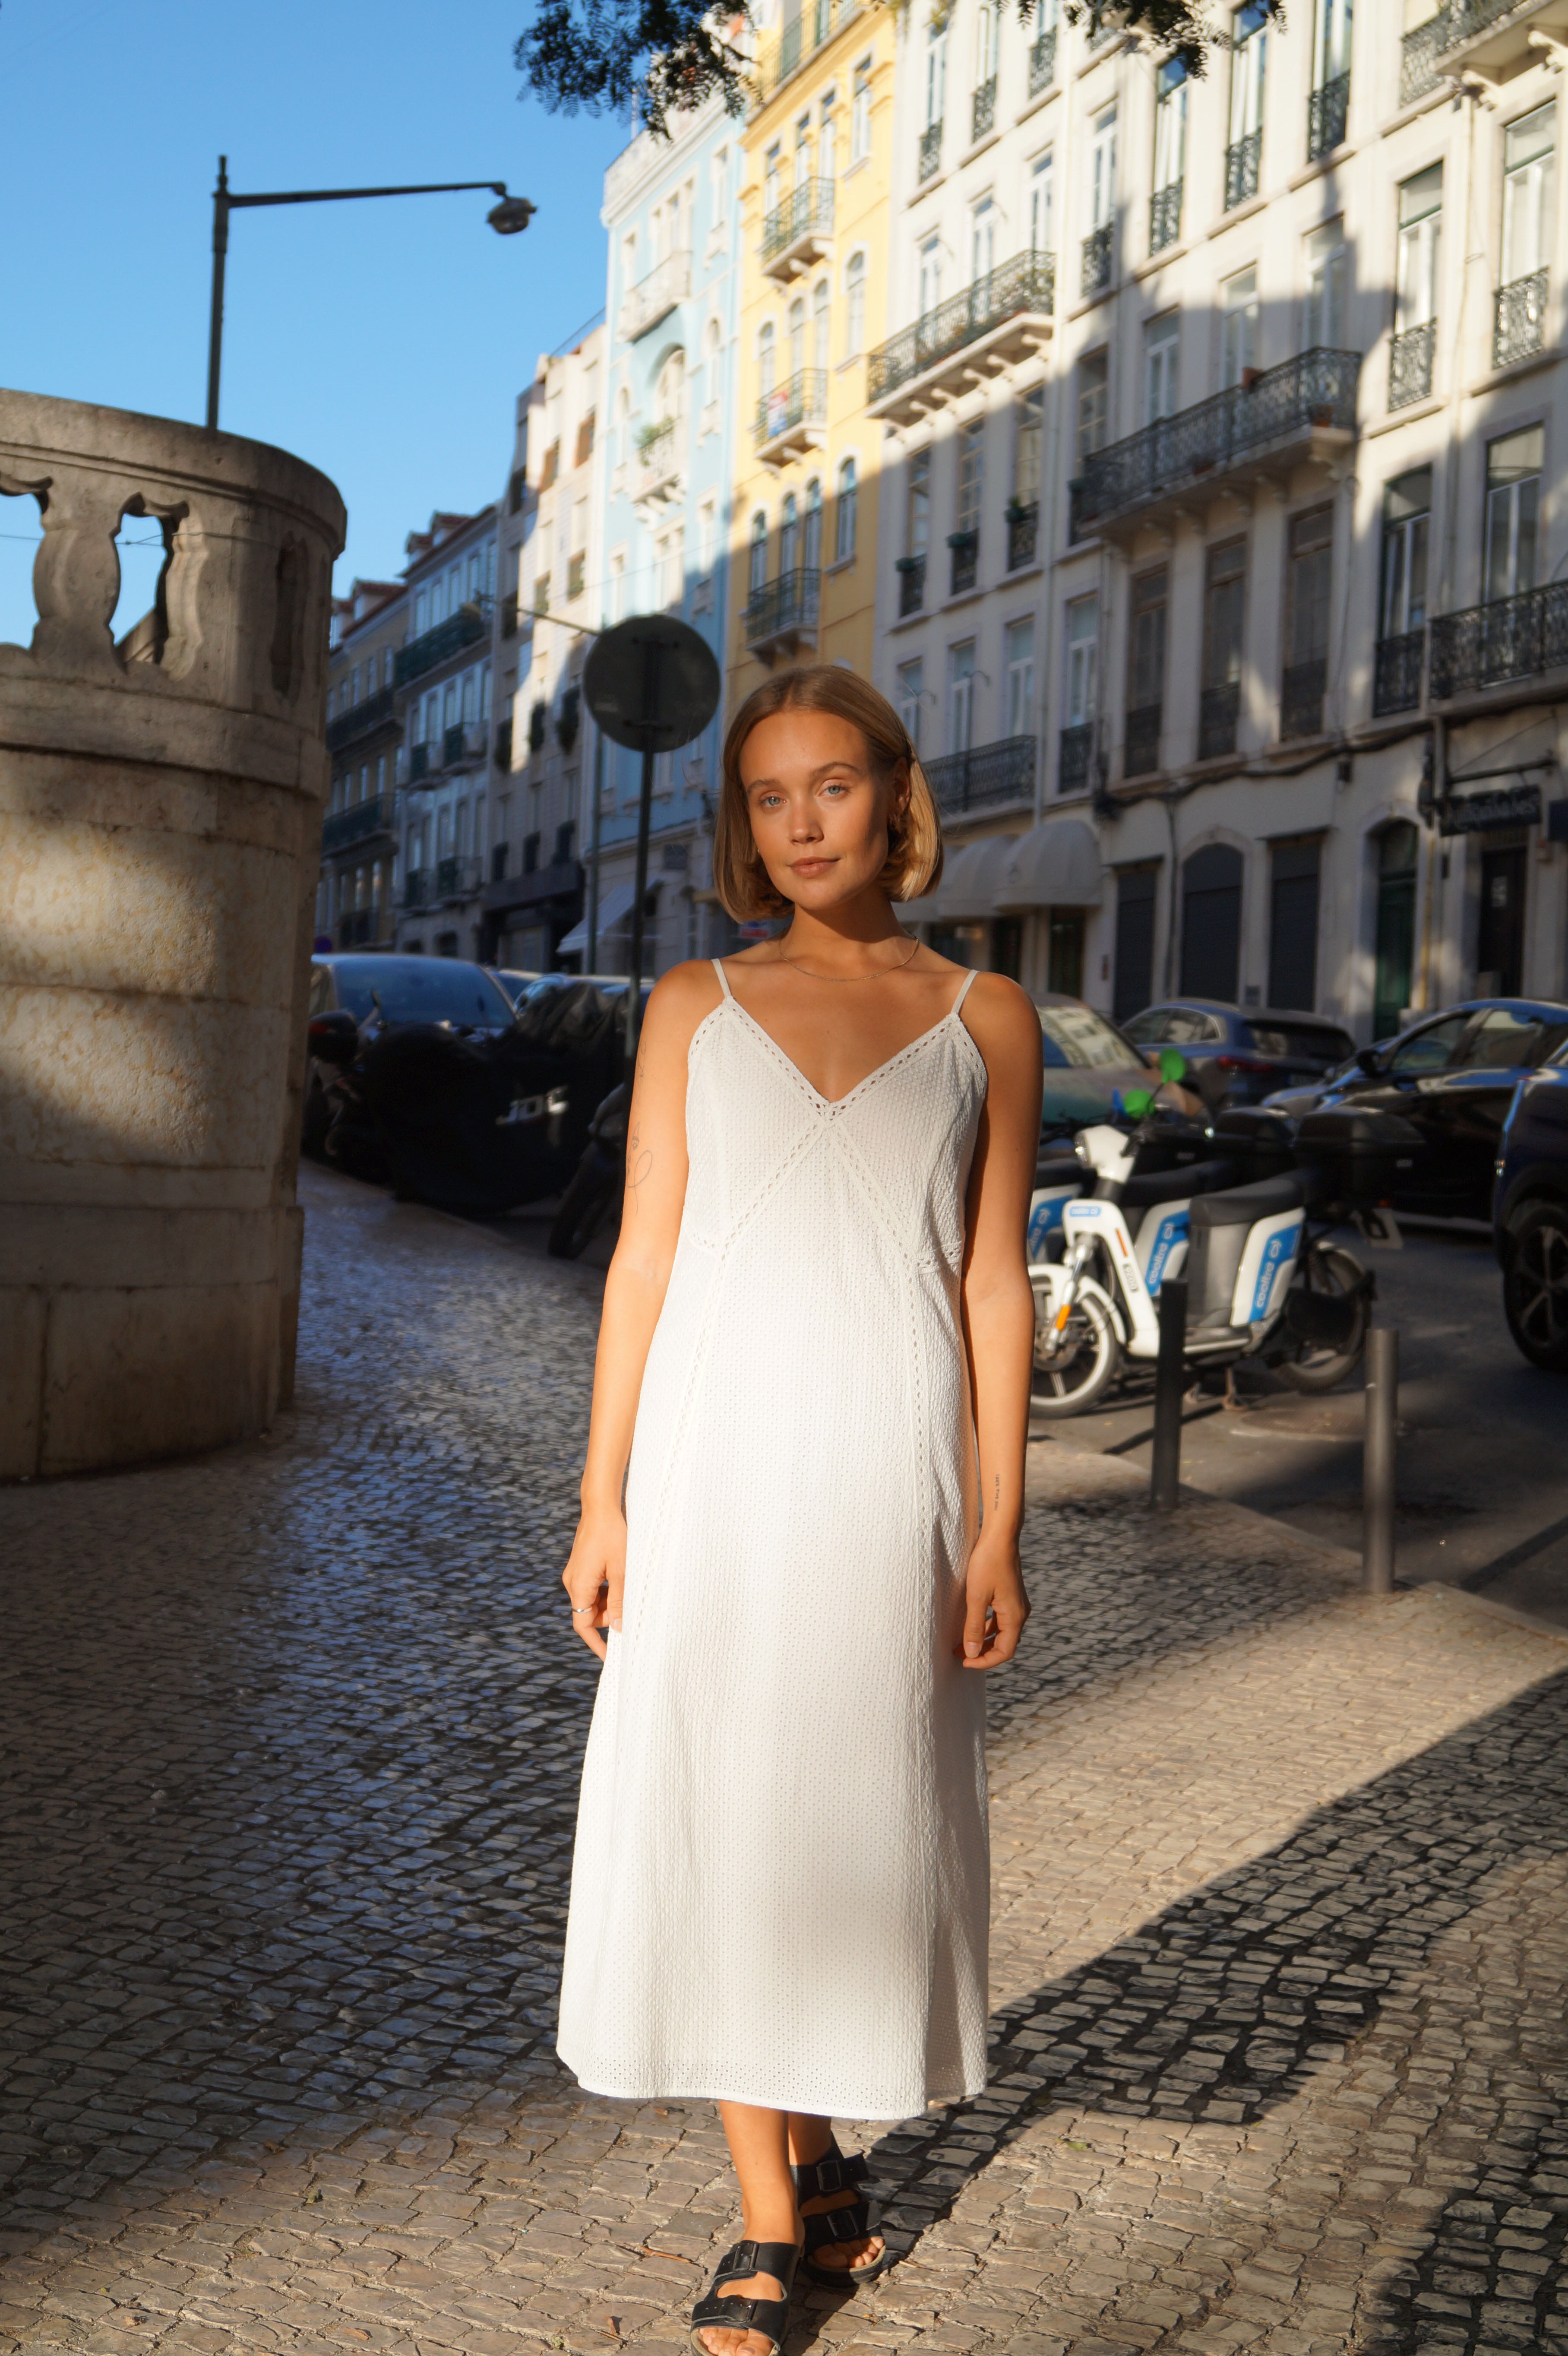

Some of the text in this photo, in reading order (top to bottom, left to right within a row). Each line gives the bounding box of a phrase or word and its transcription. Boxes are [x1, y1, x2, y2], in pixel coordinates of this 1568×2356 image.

[1124, 1267, 1137, 1290] 0026
[1148, 1241, 1168, 1284] cooltra
[1257, 1261, 1275, 1308] cooltra
